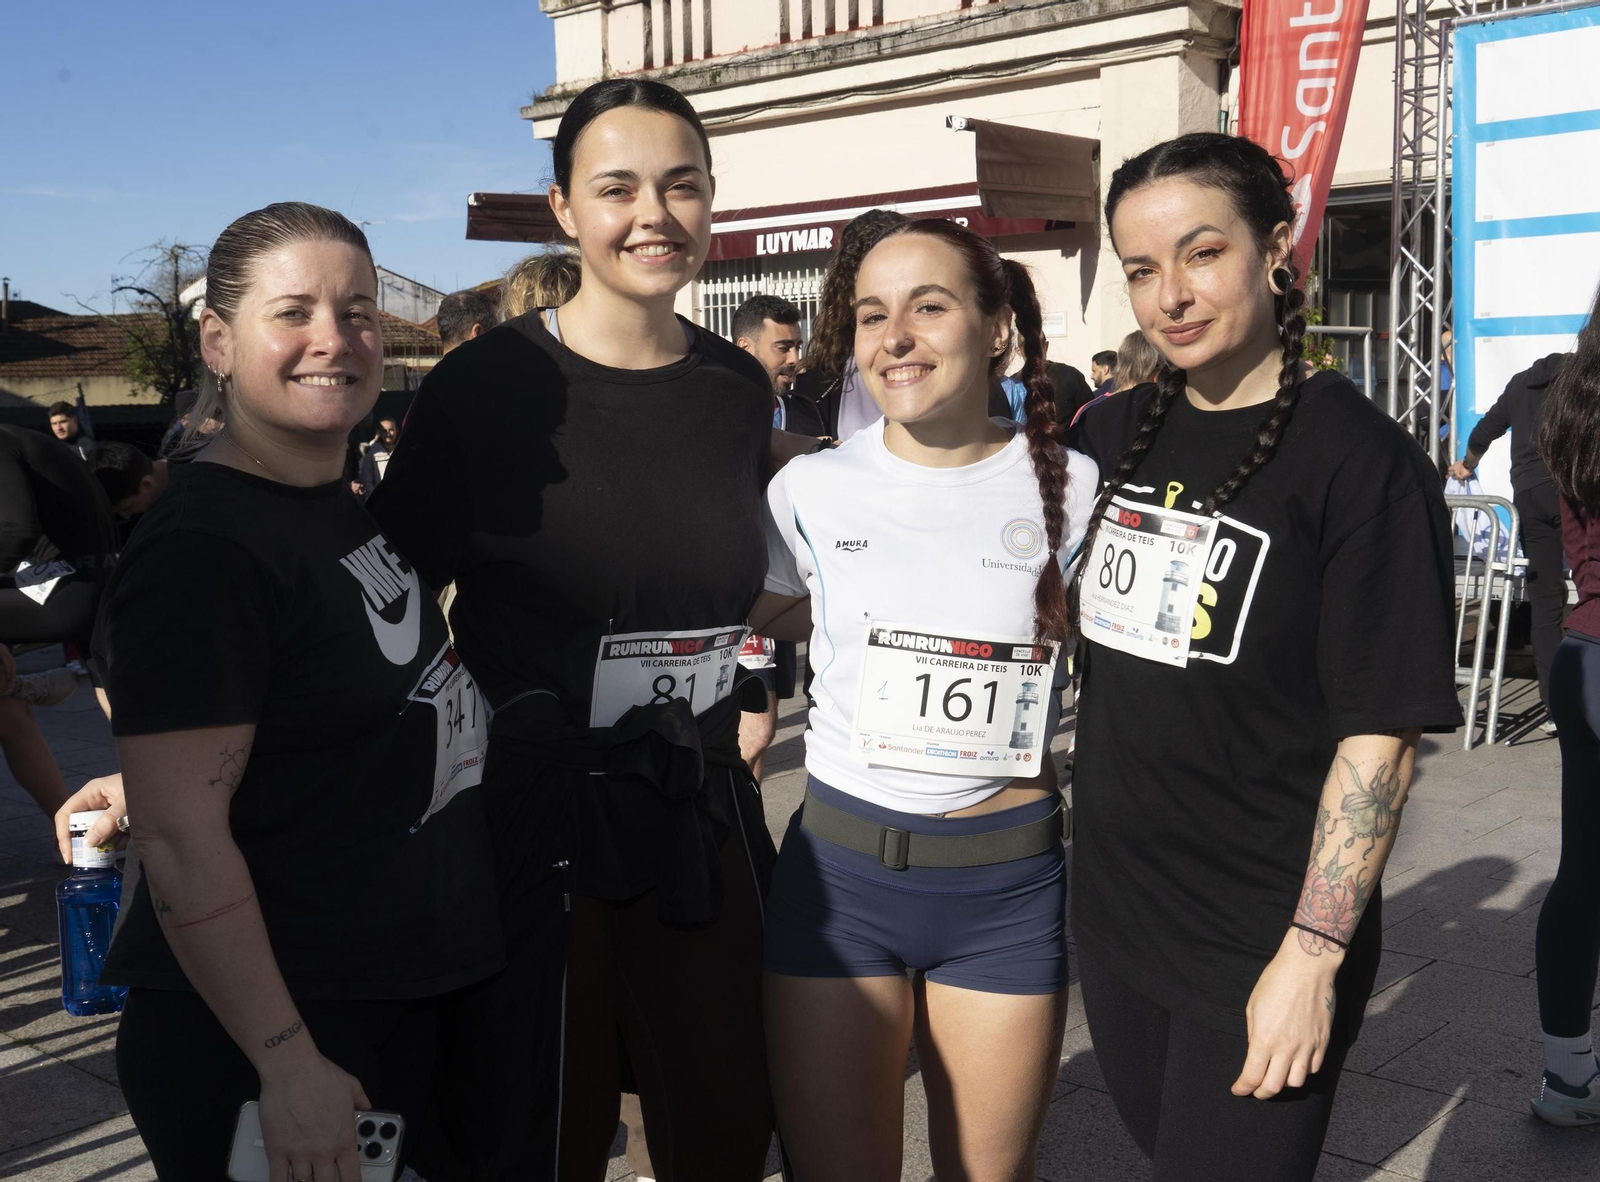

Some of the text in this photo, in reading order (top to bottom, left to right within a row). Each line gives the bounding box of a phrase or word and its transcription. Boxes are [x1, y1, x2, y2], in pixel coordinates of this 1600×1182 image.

[1280, 0, 1344, 160] Sant
[756, 227, 833, 256] LUYMAR
[835, 539, 868, 549] AMURA
[1138, 532, 1155, 546] TEIS
[1170, 540, 1198, 556] 10K
[339, 532, 412, 611] NIKE
[1099, 543, 1137, 596] 80
[719, 647, 734, 661] 10K
[640, 655, 711, 668] VII CARREIRA DE TEIS
[915, 655, 1008, 673] VII CARREIRA DE TEIS
[1020, 664, 1043, 677] 10K
[650, 673, 697, 713] 81
[915, 673, 999, 724] 161
[445, 680, 476, 750] 347
[924, 725, 934, 733] DE
[935, 726, 965, 737] ARAUJO
[965, 729, 987, 739] PEREZ
[888, 743, 925, 755] Santander
[959, 750, 978, 758] FROIZ
[462, 756, 479, 768] FROIZ
[979, 754, 1000, 762] amura
